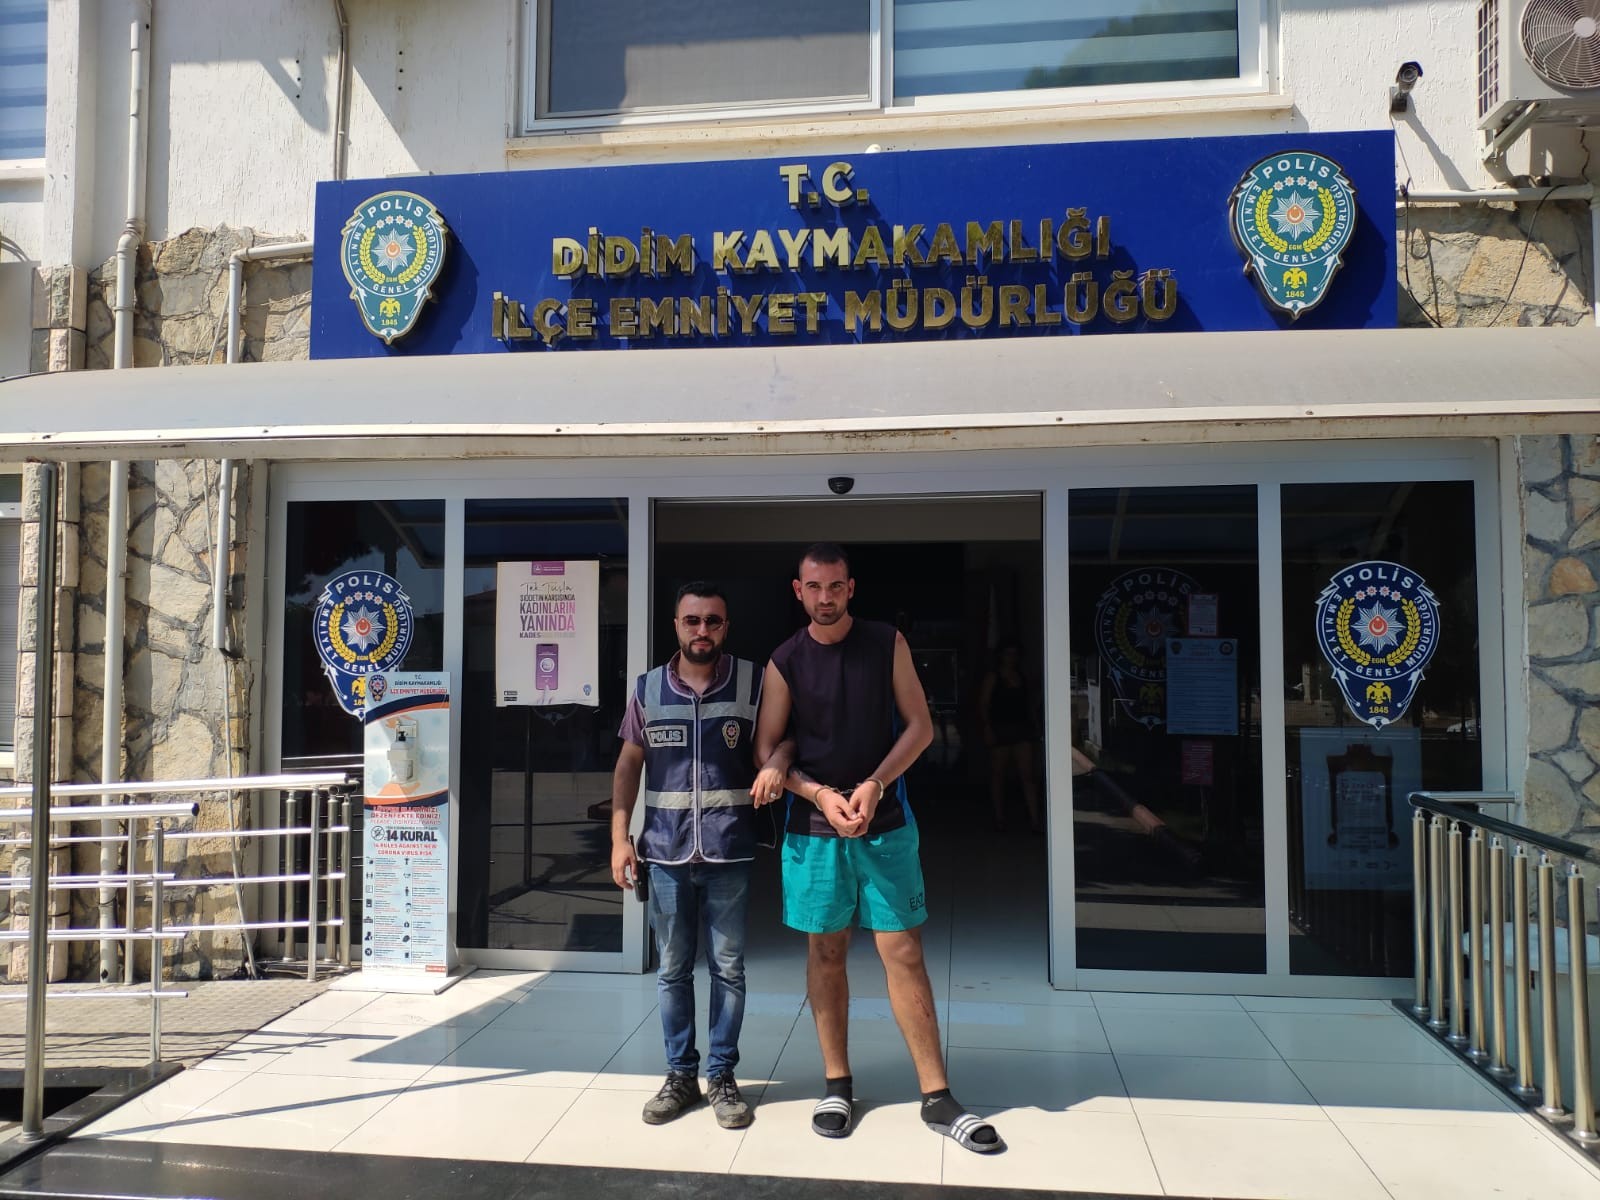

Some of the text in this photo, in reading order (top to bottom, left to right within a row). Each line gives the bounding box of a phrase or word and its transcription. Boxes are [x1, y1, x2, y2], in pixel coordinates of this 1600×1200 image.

[1262, 157, 1330, 179] POLİS
[780, 161, 869, 206] T.C.
[367, 198, 424, 218] POLİS
[552, 207, 1110, 277] DİDİM KAYMAKAMLIĞI
[1273, 251, 1317, 263] GENEL
[372, 283, 410, 294] GENEL
[491, 269, 1178, 345] İLÇE EMNİYET MÜDÜRLÜĞÜ
[335, 575, 394, 594] POLİS
[1343, 567, 1414, 589] POLİS
[520, 602, 576, 615] KADINLARIN
[520, 615, 575, 631] YANINDA
[343, 663, 381, 673] GENEL
[1355, 665, 1401, 677] GENEL
[1369, 706, 1389, 714] 1845
[386, 830, 438, 842] 14 KURAL
